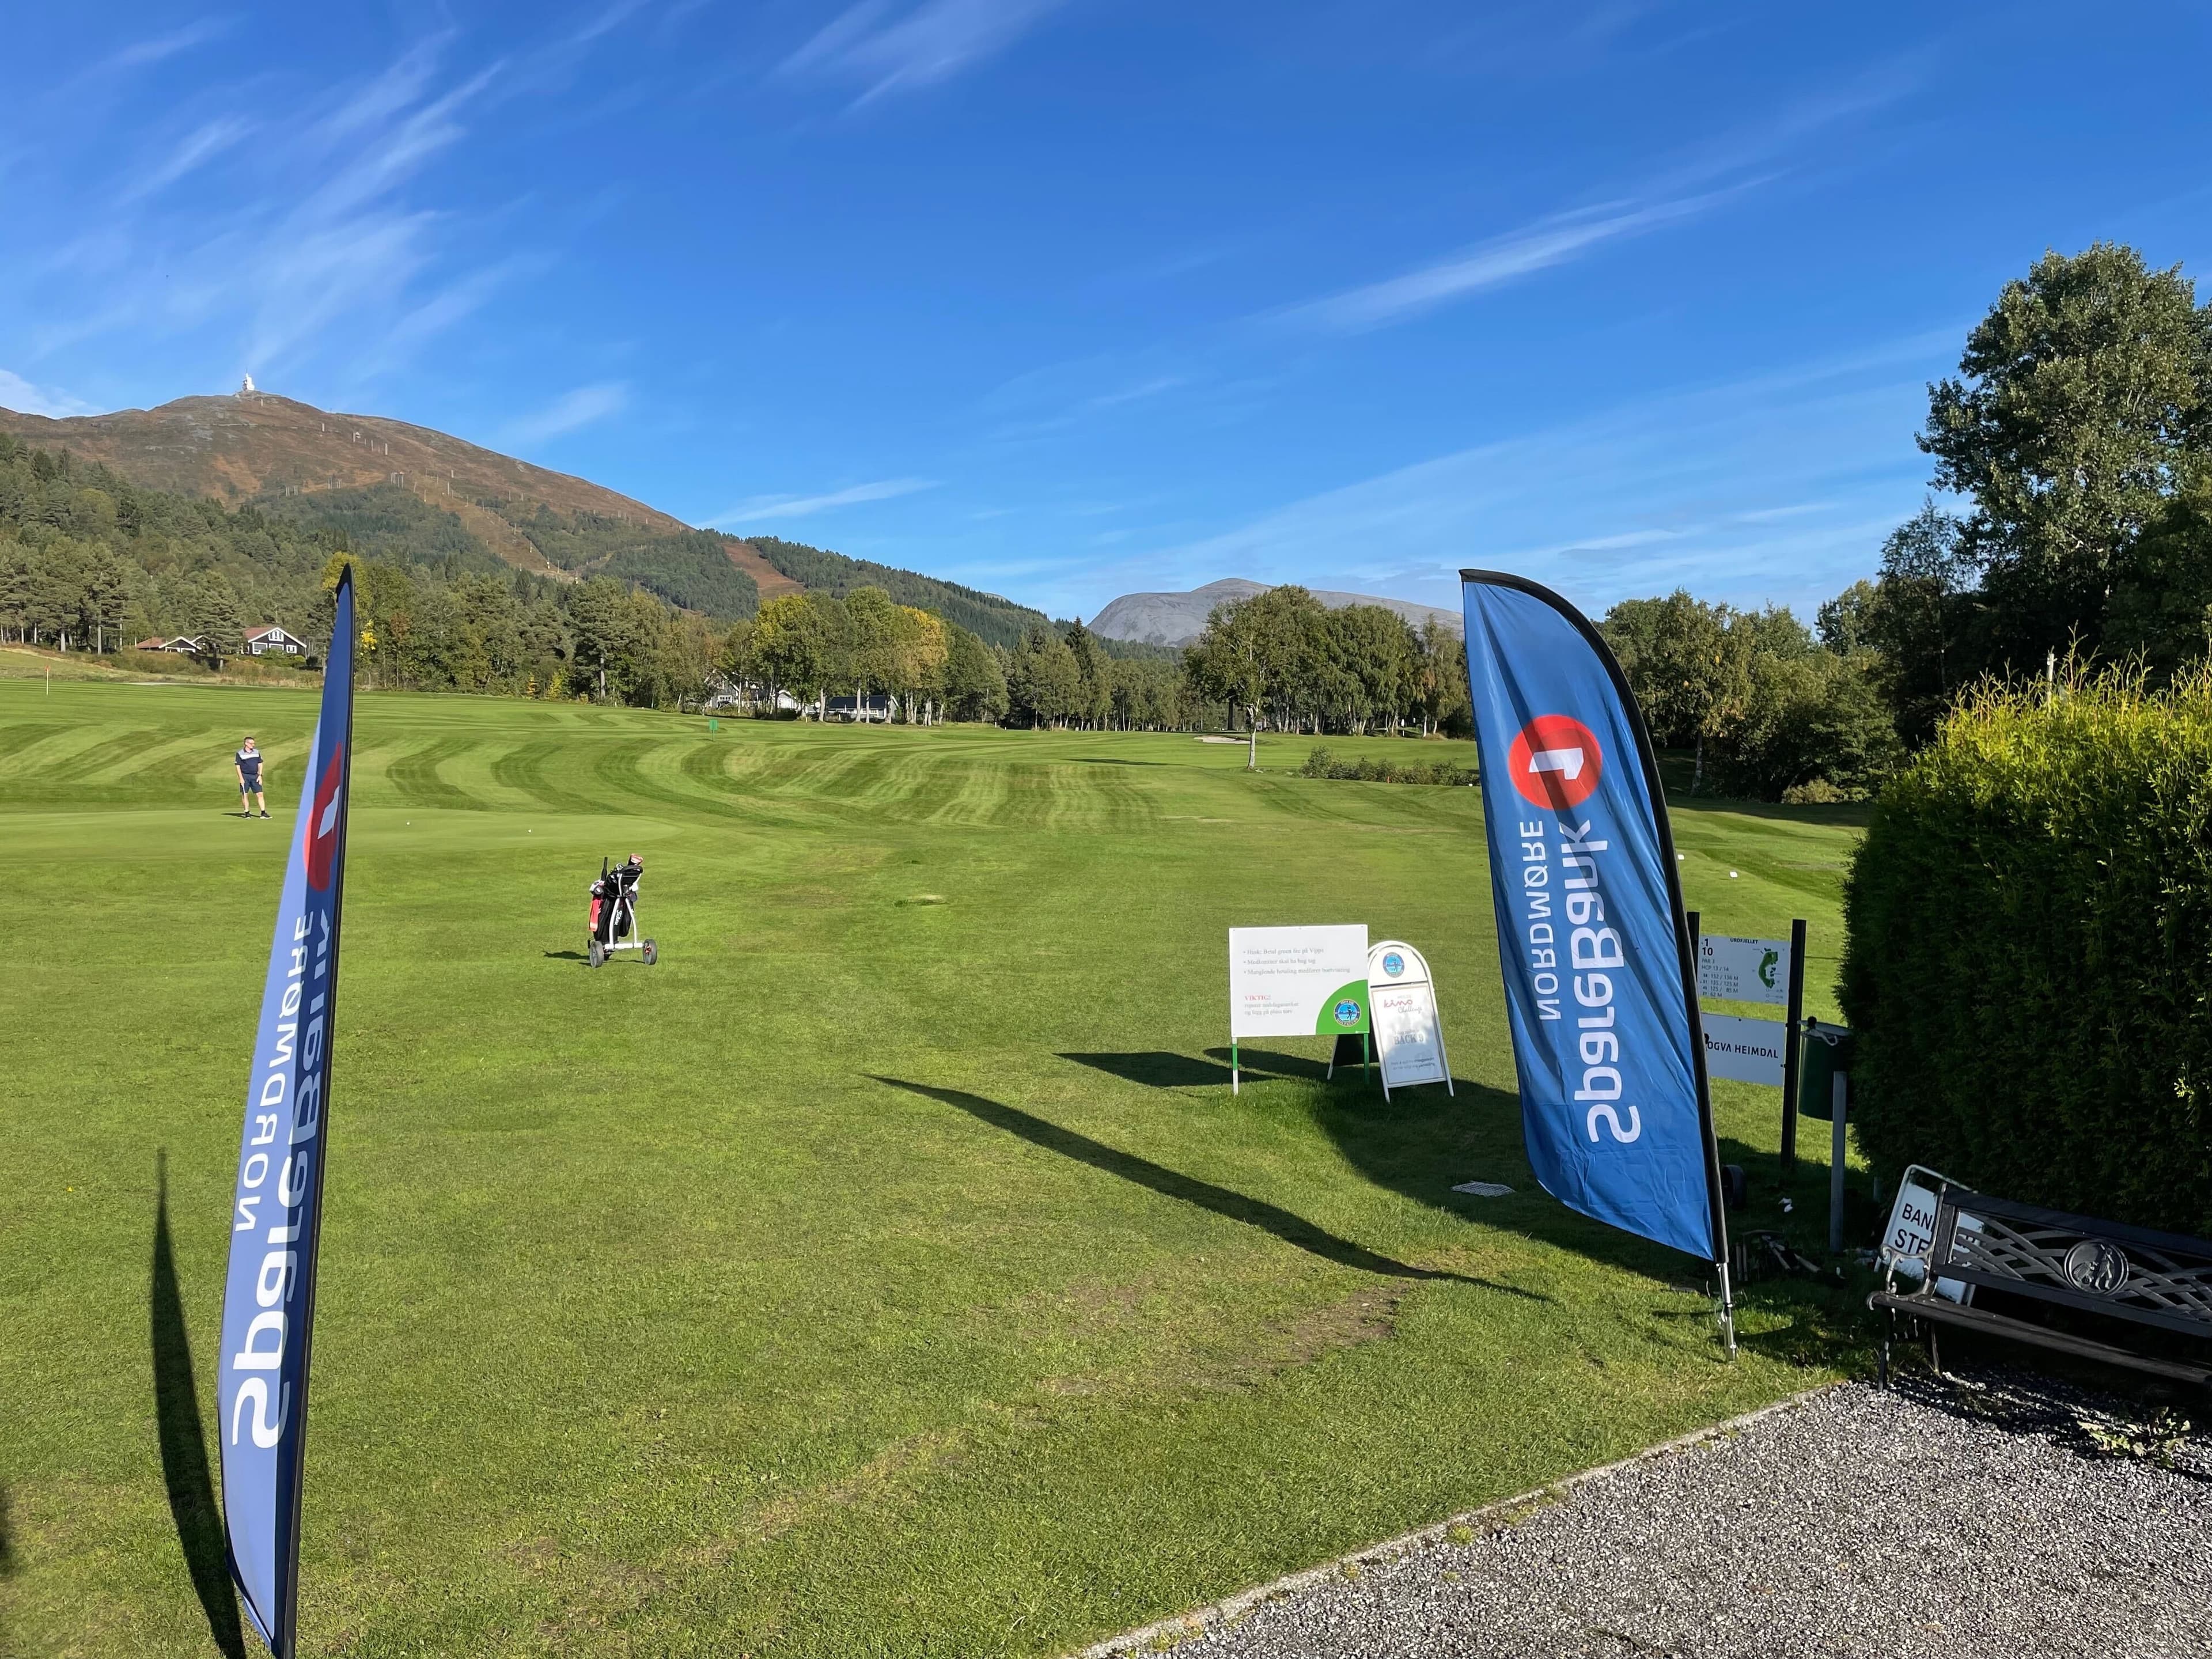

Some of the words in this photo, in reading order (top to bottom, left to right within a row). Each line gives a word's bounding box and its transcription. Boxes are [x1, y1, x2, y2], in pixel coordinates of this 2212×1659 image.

[1705, 938, 1709, 946] 1
[1702, 946, 1713, 956] 10
[1384, 999, 1413, 1008] kino
[1393, 1033, 1417, 1045] BACK
[1418, 1033, 1424, 1042] 9
[1734, 1044, 1778, 1059] HEIMDAL
